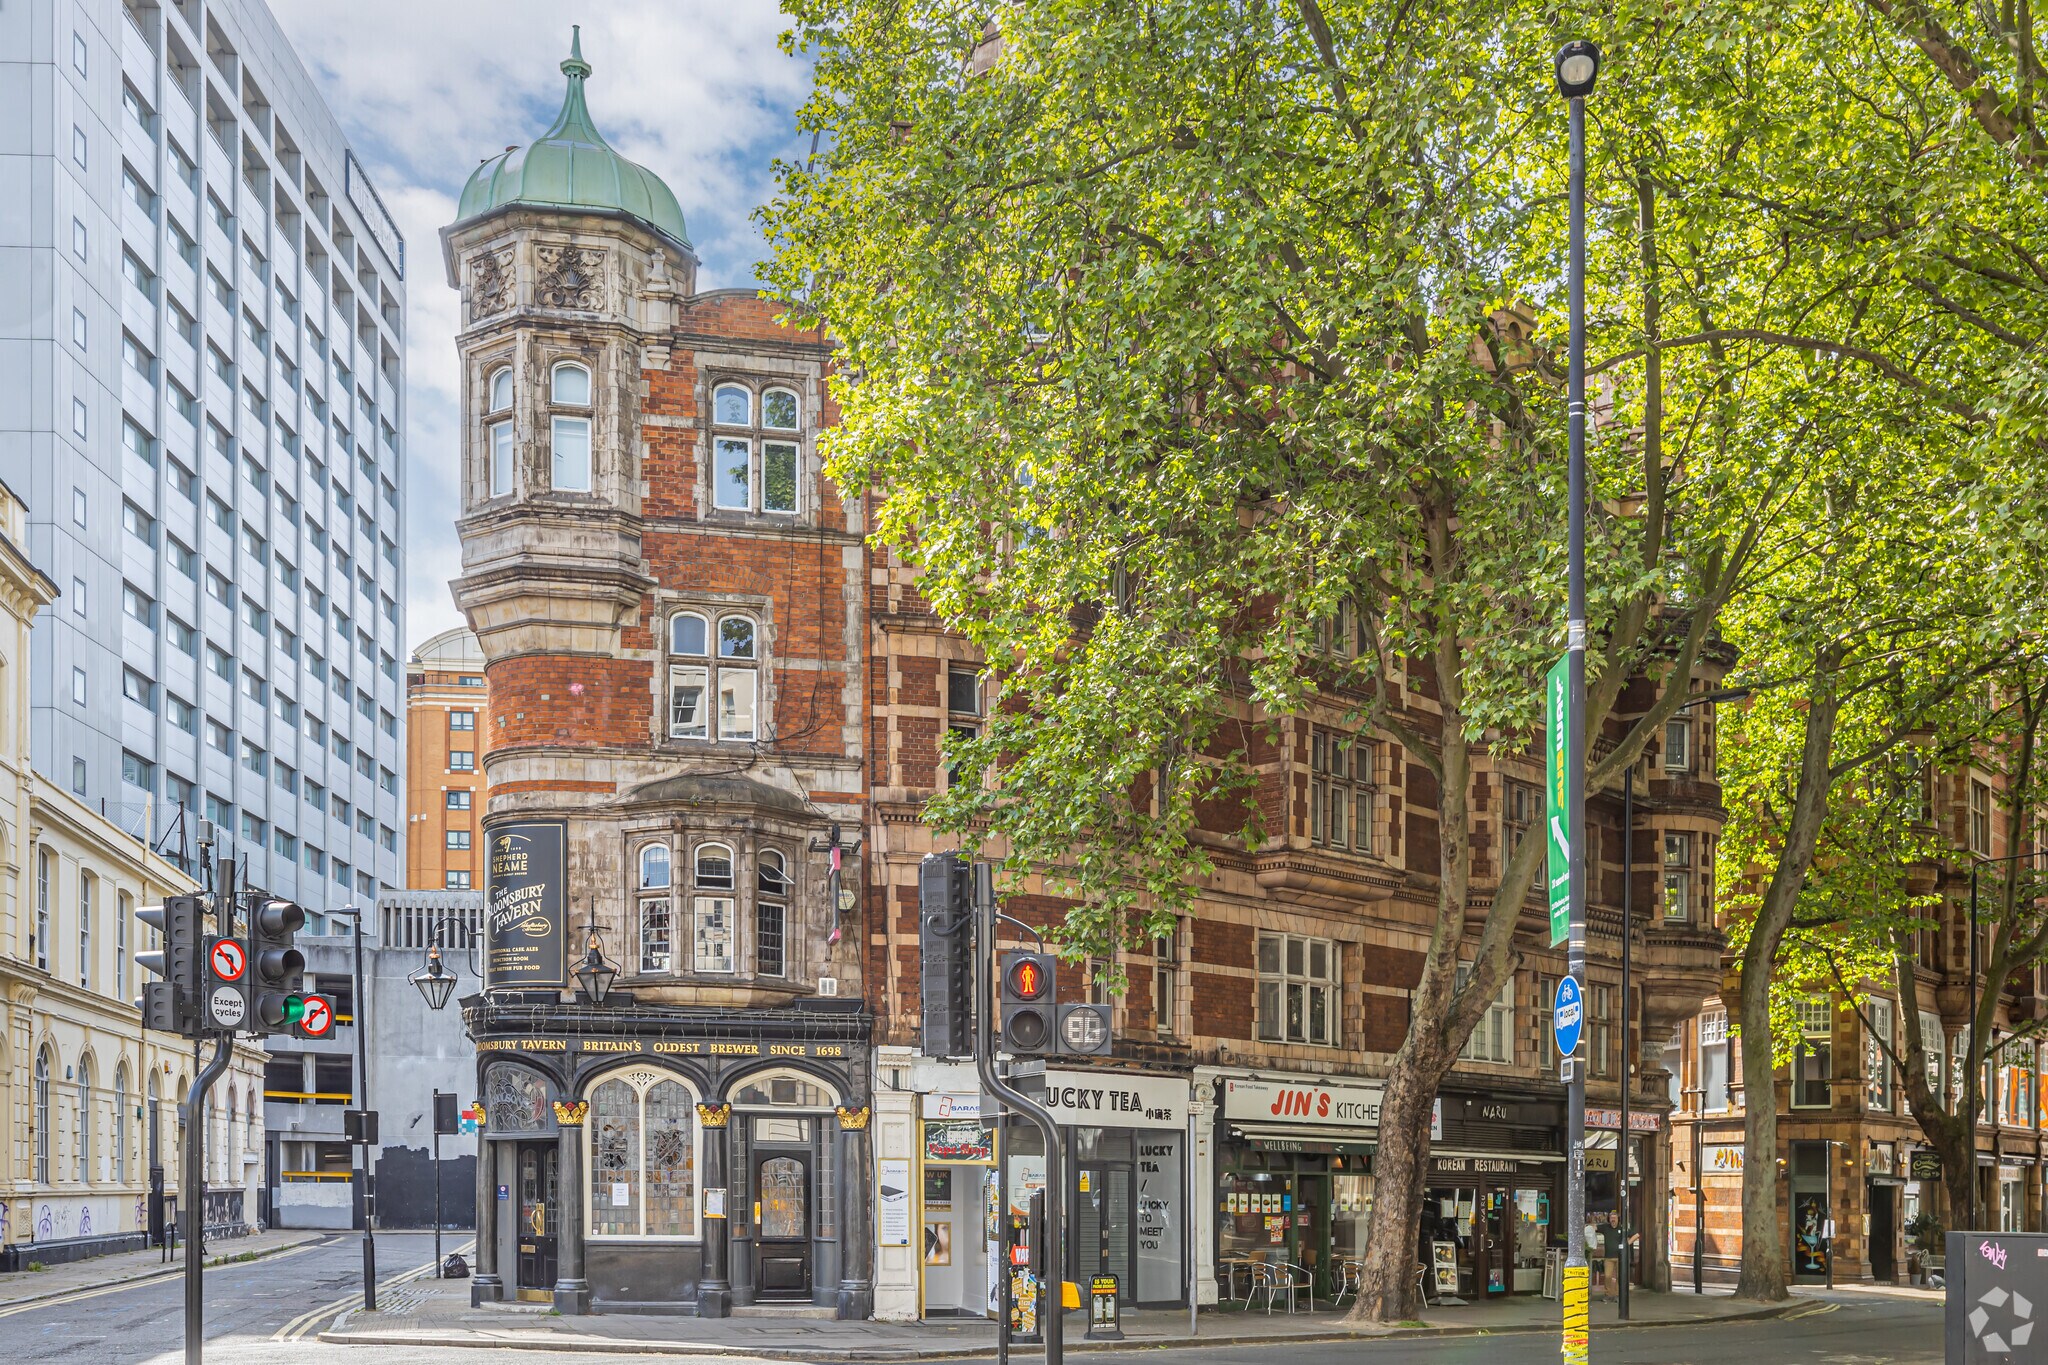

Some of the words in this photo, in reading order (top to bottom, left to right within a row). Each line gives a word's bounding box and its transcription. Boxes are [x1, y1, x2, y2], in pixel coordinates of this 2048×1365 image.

[492, 853, 528, 863] SHEPHERD
[492, 861, 528, 874] NEAME
[495, 887, 508, 899] THE
[486, 883, 546, 923] BLOOMSBURY
[493, 899, 543, 934] TAVERN
[214, 996, 243, 1008] Except
[215, 1008, 241, 1017] cycles
[1563, 1005, 1576, 1019] local
[521, 1039, 566, 1050] TAVERN
[583, 1040, 642, 1052] BRITAIN'S
[653, 1042, 700, 1053] OLDEST
[710, 1043, 759, 1054] BREWER
[770, 1045, 806, 1056] SINCE
[816, 1046, 842, 1056] 1698
[1045, 1087, 1104, 1110] UCKY
[1109, 1091, 1143, 1112] TEA
[1270, 1088, 1331, 1117] JIN'S
[1336, 1102, 1381, 1120] KITCHE
[1482, 1105, 1507, 1119] NARU
[928, 1143, 957, 1158] Vape
[960, 1143, 989, 1158] Shop
[1140, 1145, 1174, 1156] LUCKY
[1263, 1140, 1302, 1151] WELLBEING
[1140, 1161, 1160, 1172] TEA
[1437, 1158, 1466, 1171] KOREAN
[1474, 1160, 1517, 1173] RESTAURANT
[1585, 1157, 1609, 1168] ARU
[1141, 1214, 1152, 1223] TO
[1140, 1227, 1164, 1236] MEET
[1140, 1240, 1159, 1249] YOU
